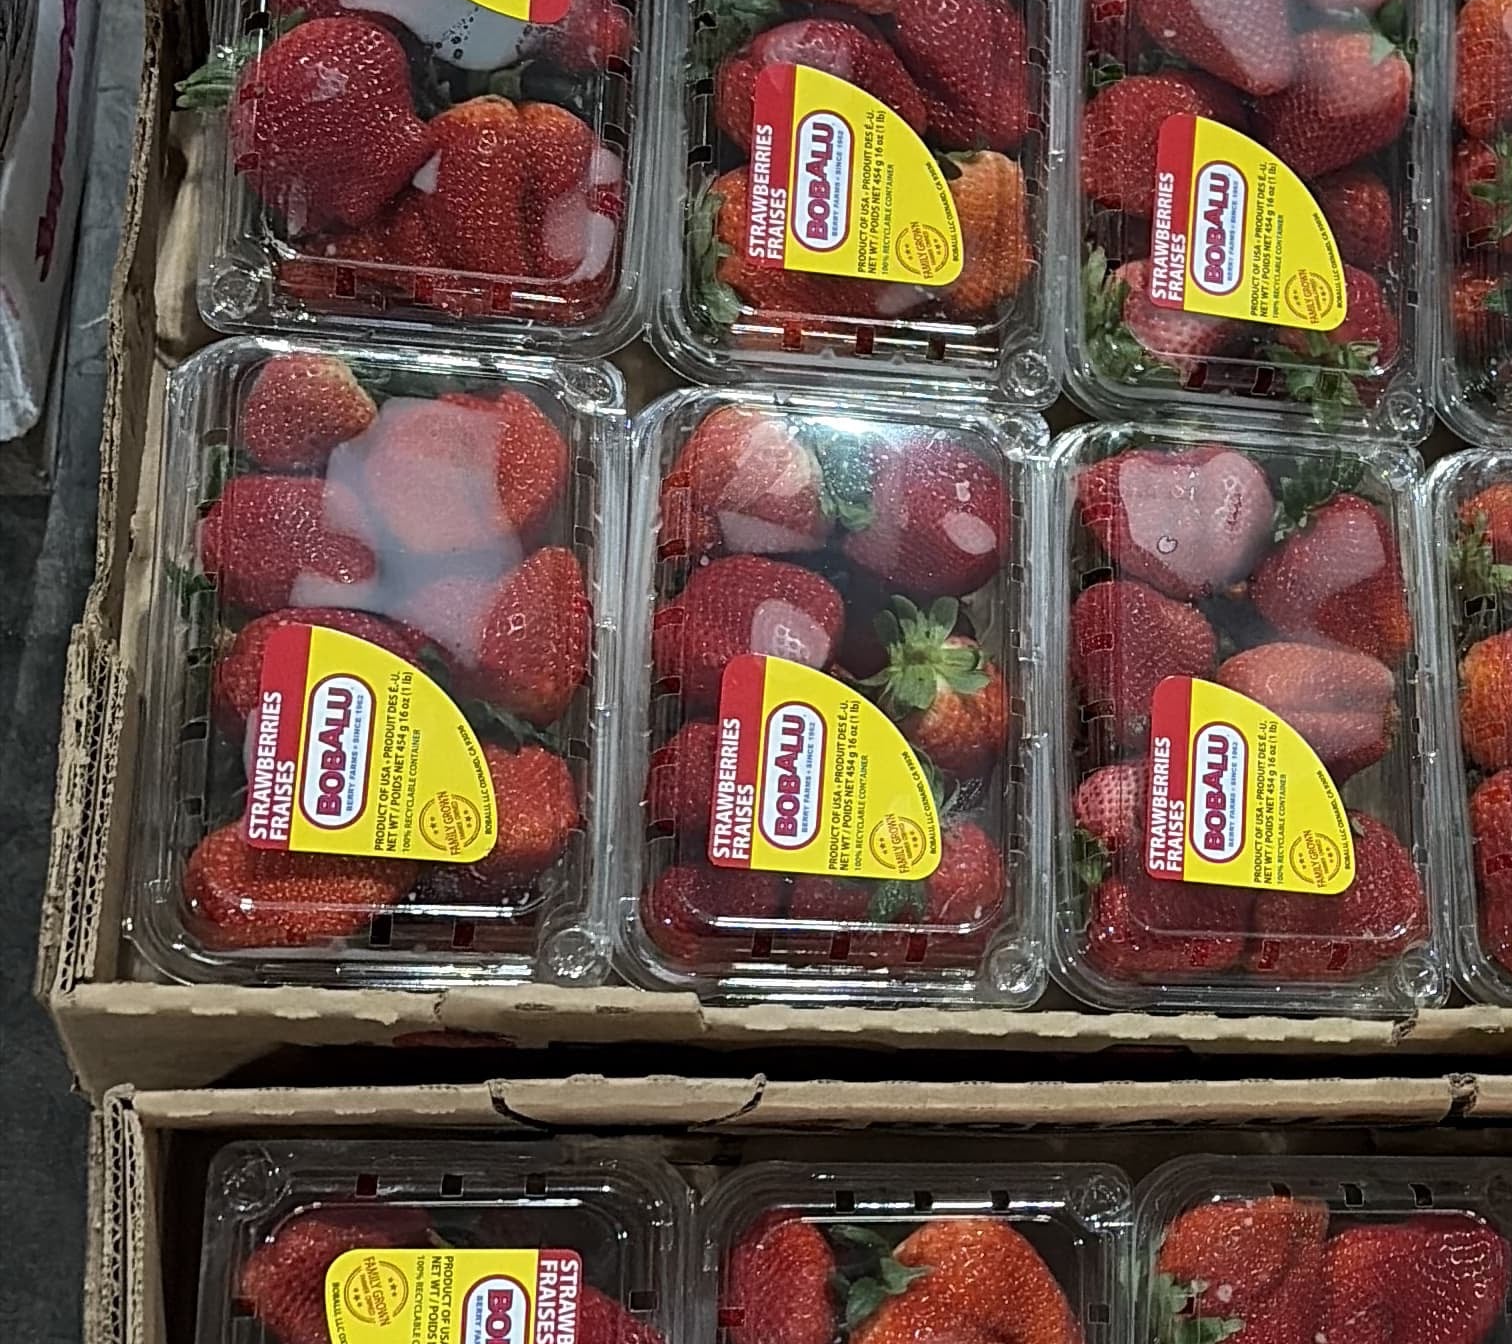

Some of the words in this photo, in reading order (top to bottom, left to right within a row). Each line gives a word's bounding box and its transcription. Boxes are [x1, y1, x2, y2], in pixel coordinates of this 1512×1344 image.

[749, 123, 772, 257] STRAWBERRIES
[767, 186, 786, 259] FRAISES
[805, 122, 834, 240] BOBALU
[1151, 171, 1173, 299] STRAWBERRIES
[1203, 172, 1230, 284] BOBALU
[1168, 232, 1185, 301] FRAISES
[248, 690, 282, 838] STRAWBERRIES
[269, 759, 295, 840] FRAISES
[316, 686, 353, 816] BOBALU
[712, 717, 740, 858] STRAWBERRIES
[774, 714, 805, 836] BOBALU
[1149, 735, 1170, 870] STRAWBERRIES
[1202, 733, 1229, 850] BOBALU
[732, 783, 753, 859] FRAISES
[1167, 798, 1184, 871] FRAISES
[536, 1259, 557, 1344] FRAISES
